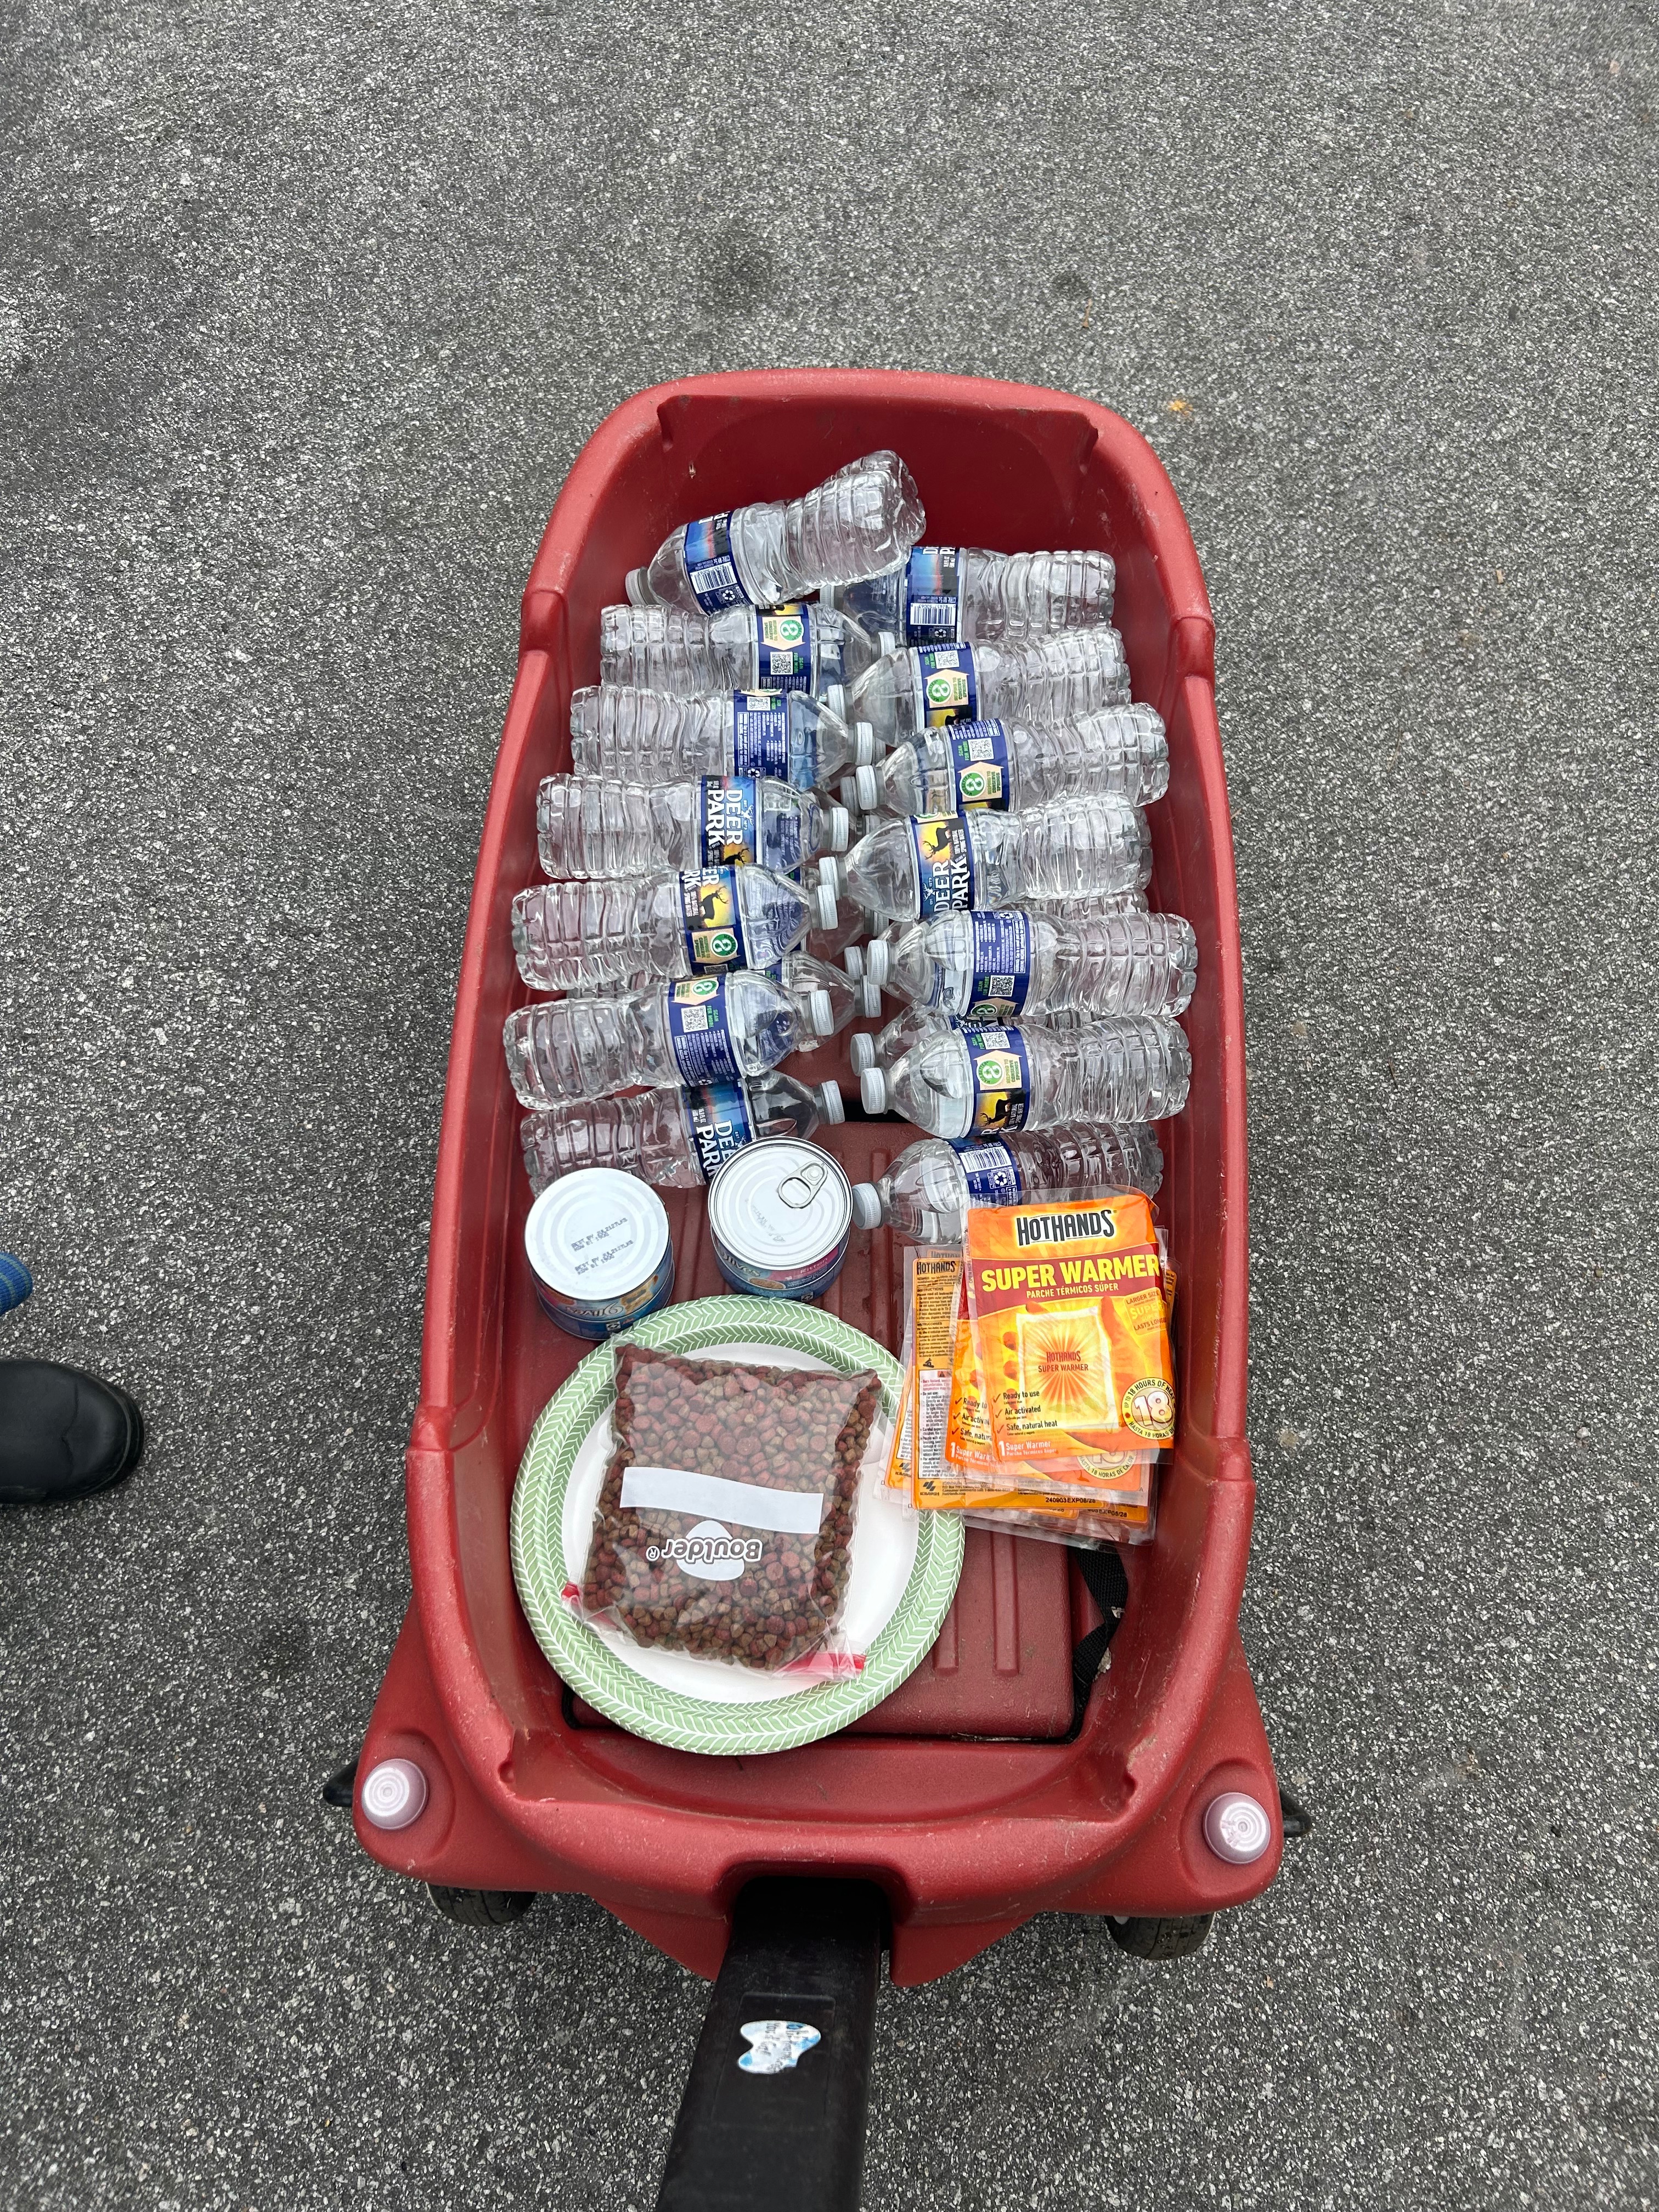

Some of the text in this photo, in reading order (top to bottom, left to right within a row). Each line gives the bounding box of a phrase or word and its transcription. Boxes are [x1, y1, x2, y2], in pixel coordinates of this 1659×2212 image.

[706, 789, 725, 846] PARK
[726, 789, 743, 845] DEER
[681, 870, 702, 890] RK
[702, 867, 720, 887] ER
[950, 856, 970, 910] PARK
[933, 859, 950, 912] DEER
[714, 1120, 737, 1161] DEE
[1017, 1209, 1114, 1246] HOTHANDS
[917, 1260, 956, 1275] HOTHANDS
[981, 1264, 1057, 1292] SUPER
[1059, 1254, 1160, 1284] WARMER
[1026, 1282, 1119, 1299] PARCHE TÉRMICOS SÚPER
[1126, 1294, 1148, 1304] LARGER
[1133, 1322, 1150, 1331] LASTS
[1046, 1351, 1081, 1363] HOTHANDS
[1038, 1363, 1089, 1373] SUPER WARMER
[1134, 1379, 1155, 1391] HOURS
[963, 1397, 980, 1409] Ready
[1003, 1391, 1020, 1400] Ready
[1014, 1405, 1041, 1414] activated
[1134, 1390, 1173, 1426] 18
[960, 1427, 973, 1438] Safe,
[1022, 1420, 1043, 1430] natural
[1128, 1421, 1143, 1435] HASTA
[951, 1442, 973, 1458] 1 Super
[998, 1441, 1005, 1456] 1
[1006, 1442, 1024, 1451] Super
[1079, 1456, 1091, 1470] HASTA
[1123, 1455, 1134, 1470] CALOR
[661, 1538, 763, 1564] Boulder
